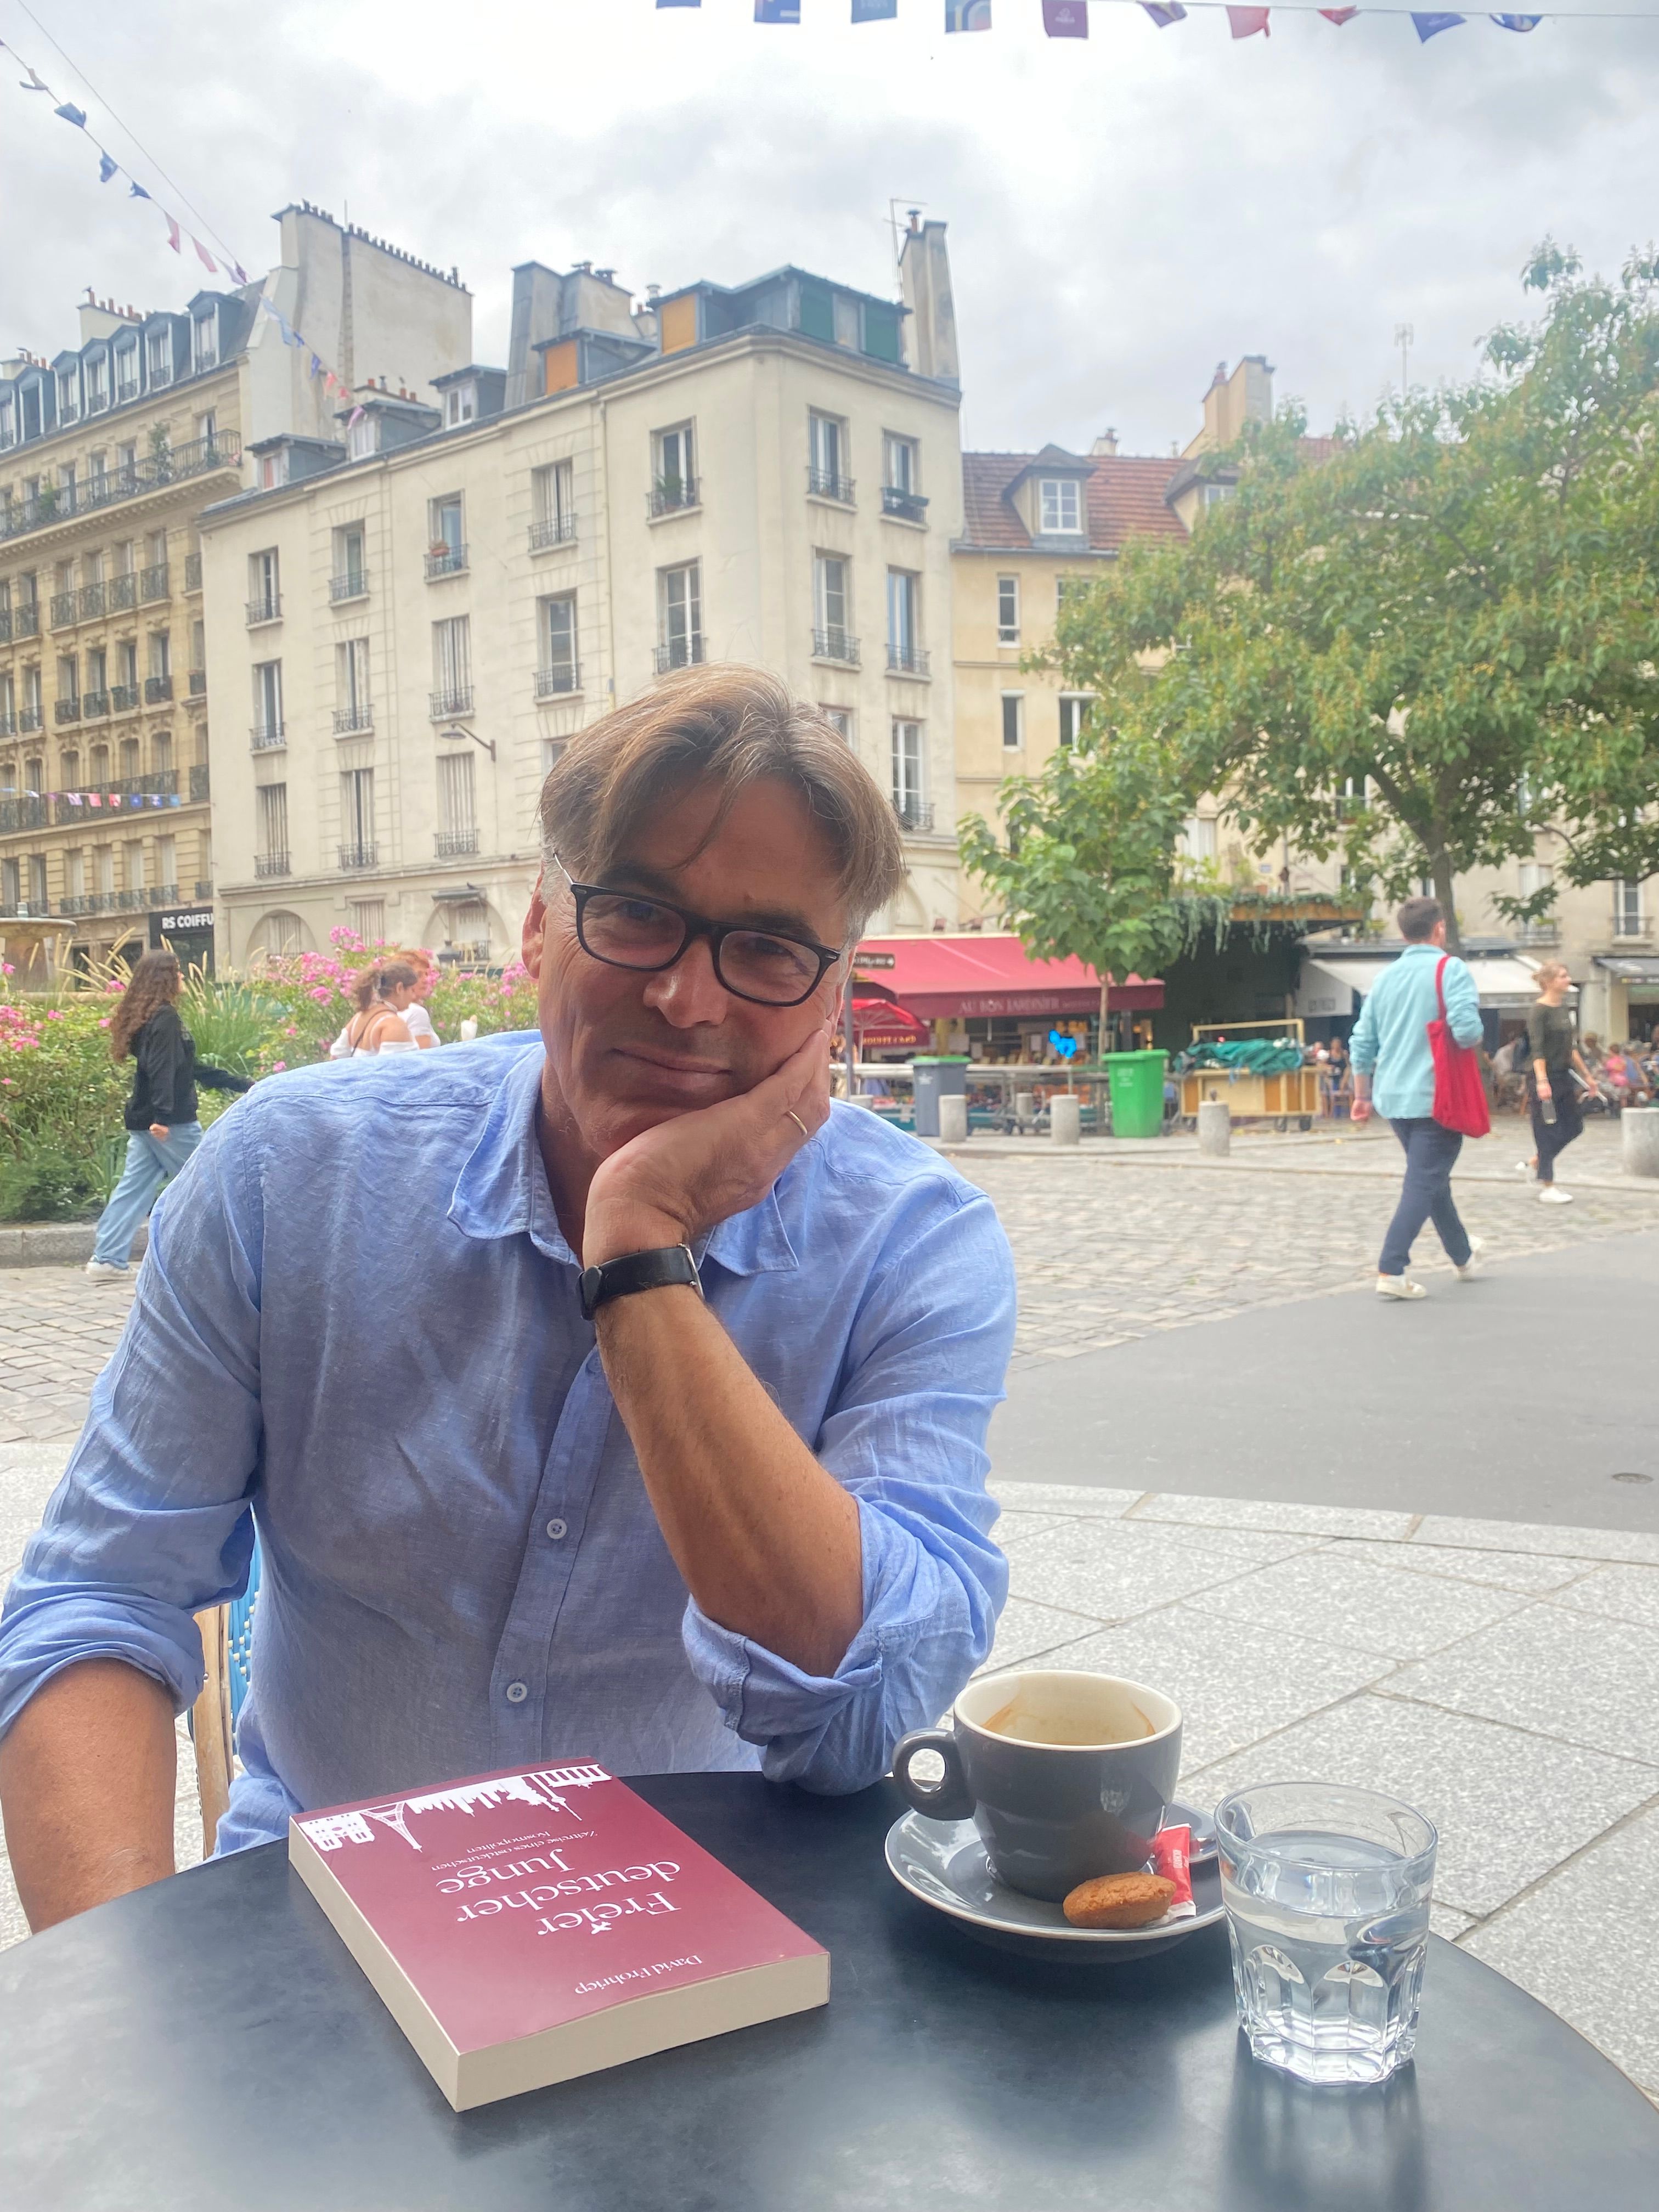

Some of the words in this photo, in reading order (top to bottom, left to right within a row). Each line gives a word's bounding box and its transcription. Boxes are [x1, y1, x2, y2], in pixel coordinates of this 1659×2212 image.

[162, 916, 176, 929] RS
[466, 1830, 551, 1854] Kosmopoliten
[512, 1840, 545, 1851] eines
[547, 1830, 598, 1844] Zeitreise
[431, 1847, 512, 1871] ostdeutschen
[436, 1848, 575, 1894] Junge
[456, 1860, 681, 1922] deutscher
[535, 1891, 681, 1936] Freier
[651, 1955, 703, 1975] David
[574, 1967, 652, 1994] Frohriep
